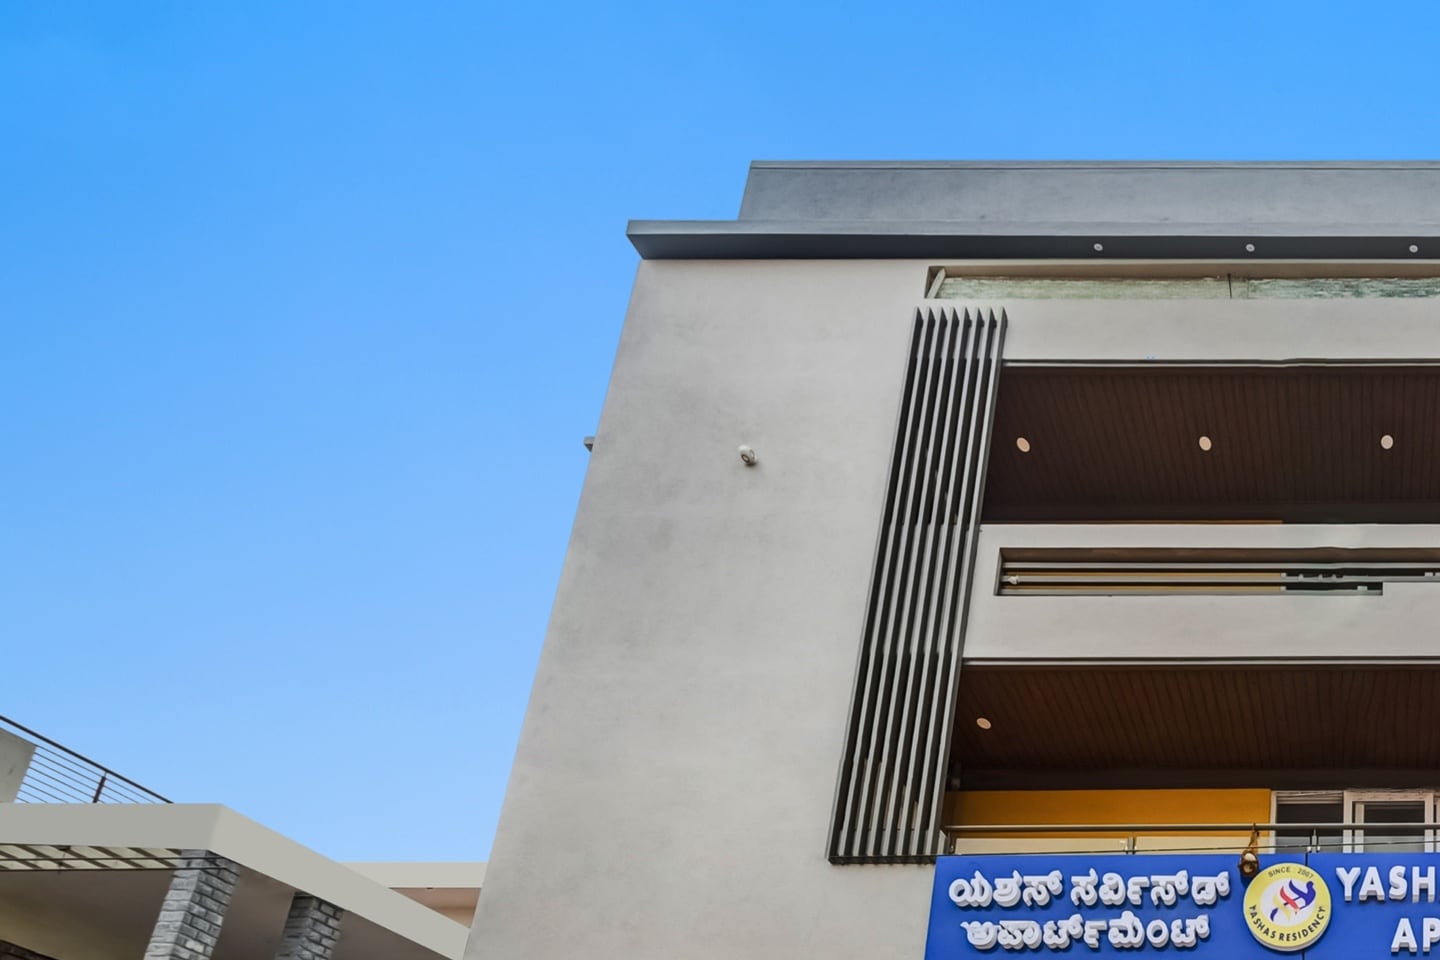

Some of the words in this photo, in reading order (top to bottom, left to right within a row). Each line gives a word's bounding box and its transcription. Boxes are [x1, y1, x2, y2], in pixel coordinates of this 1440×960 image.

[1268, 866, 1291, 877] SINCE
[1249, 904, 1277, 939] YASHAS
[1279, 905, 1326, 942] RESIDENCY
